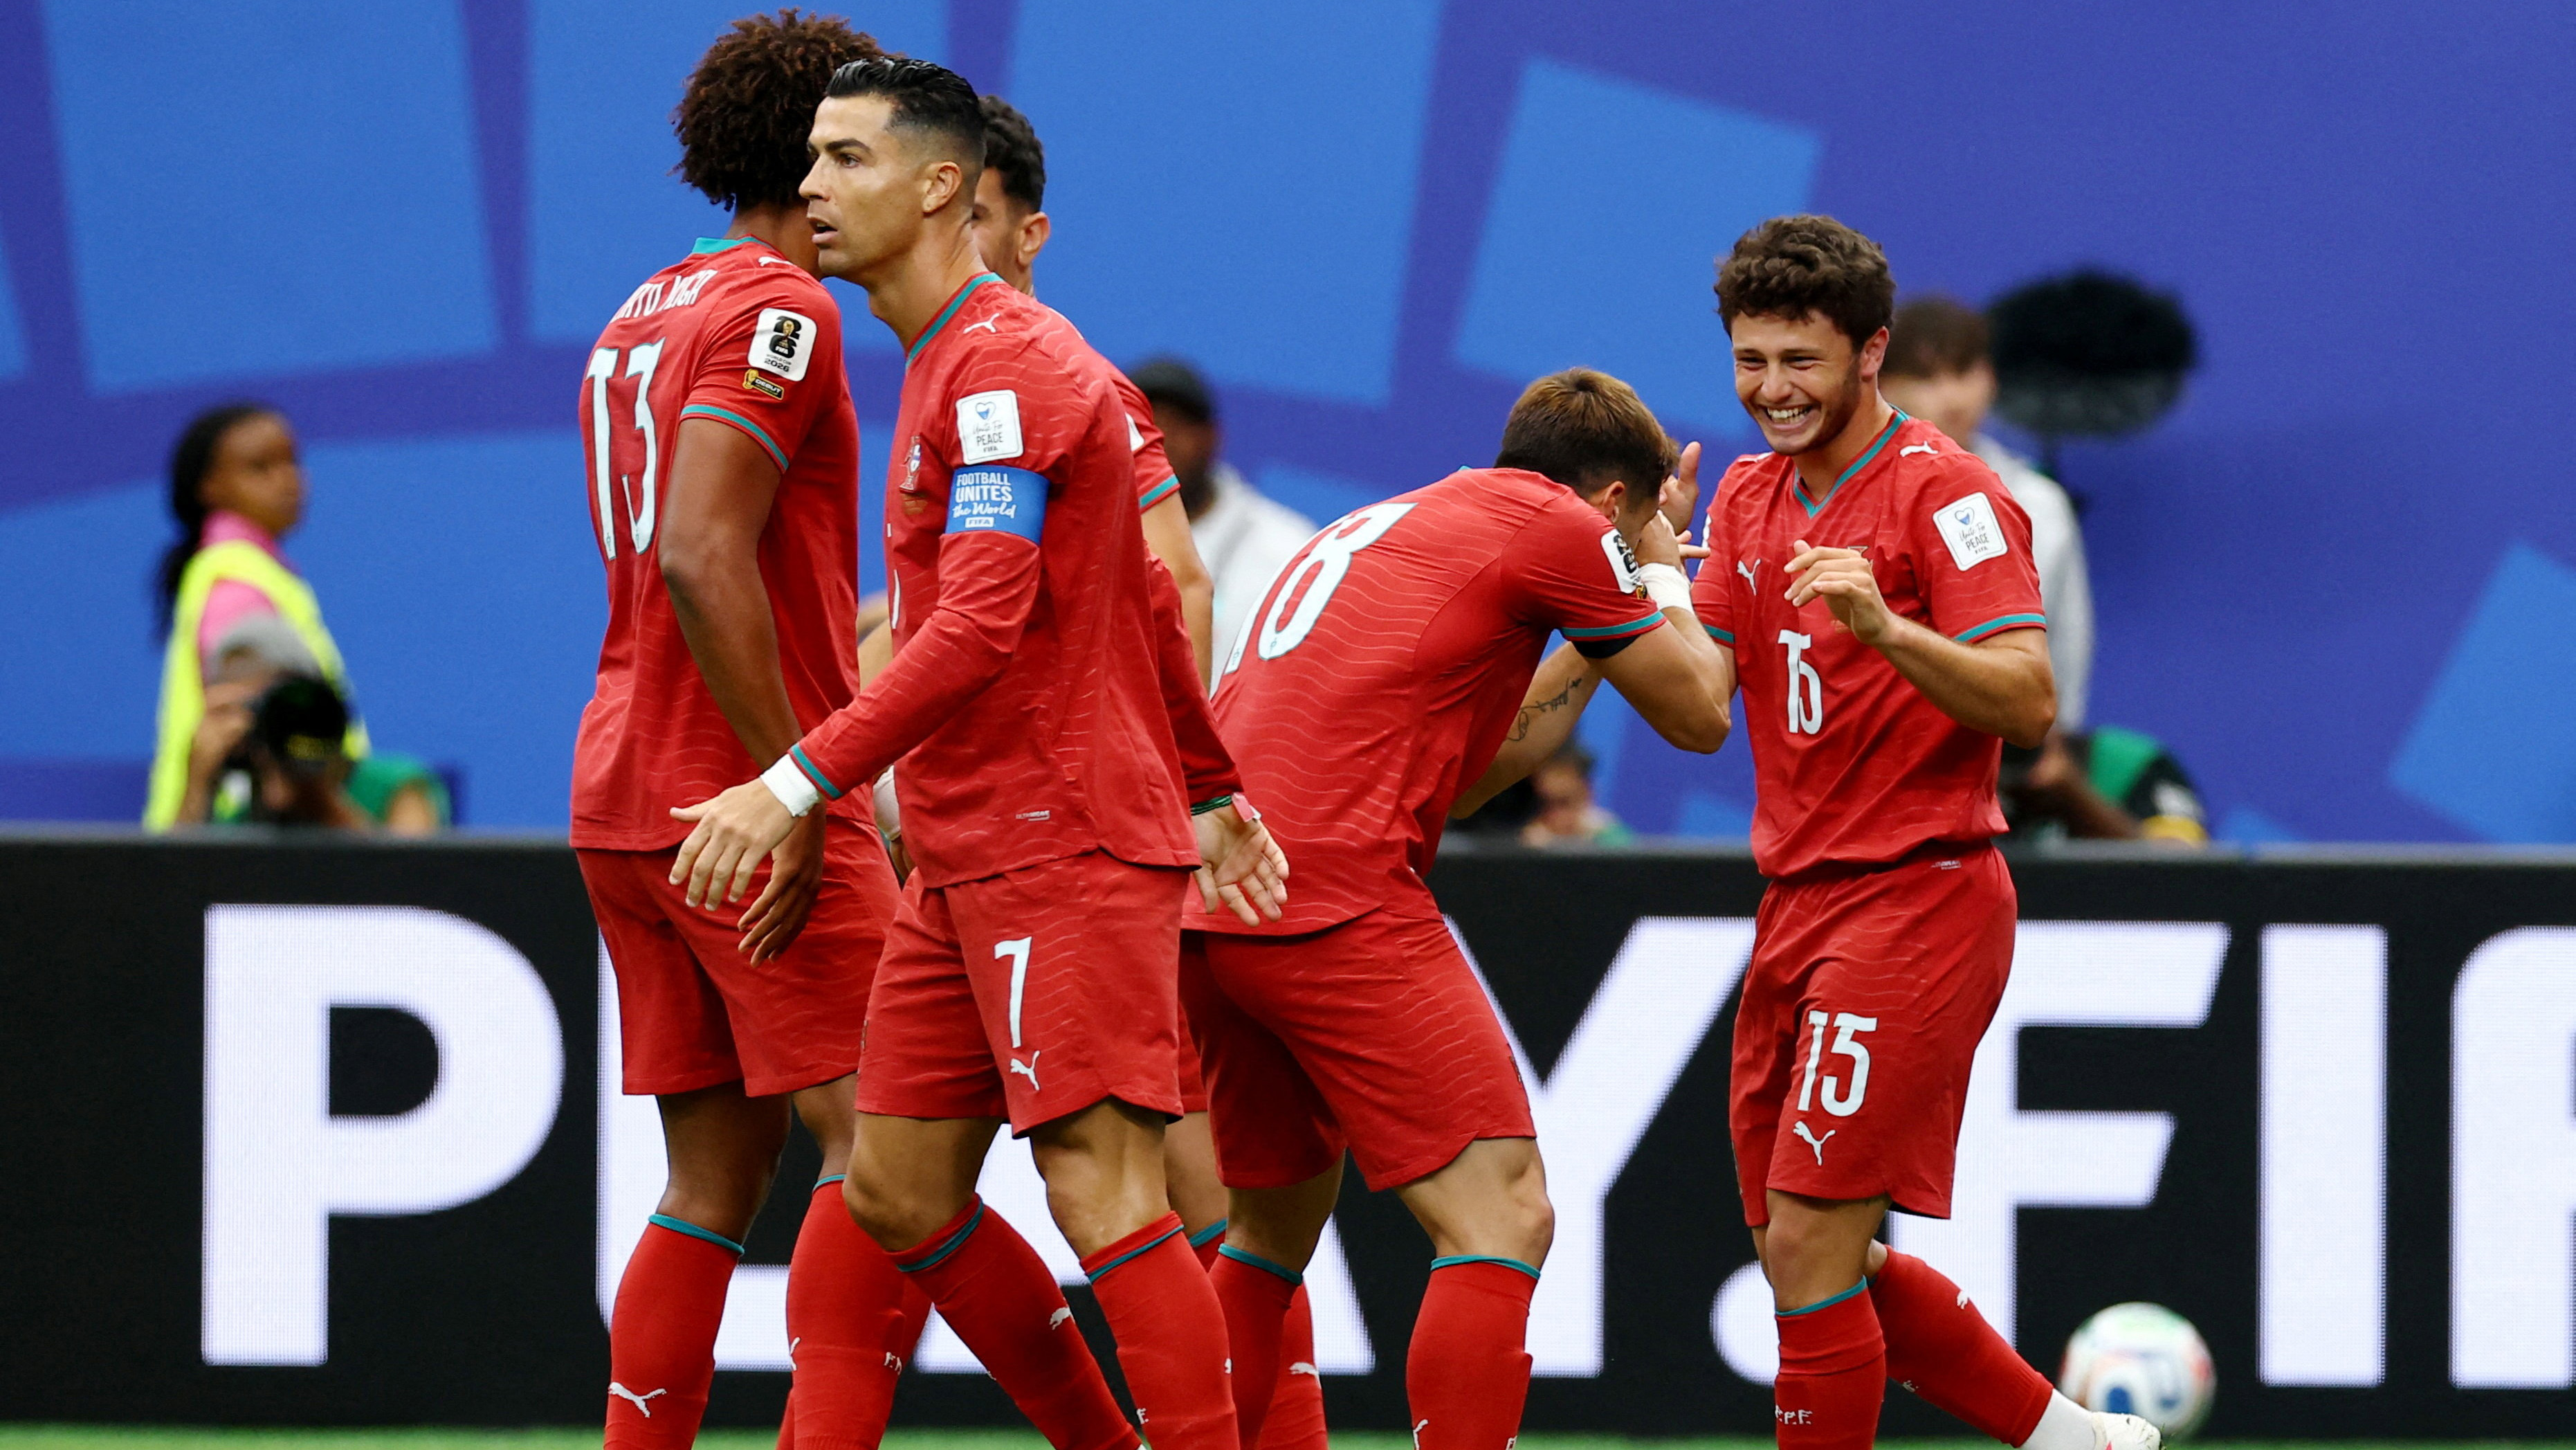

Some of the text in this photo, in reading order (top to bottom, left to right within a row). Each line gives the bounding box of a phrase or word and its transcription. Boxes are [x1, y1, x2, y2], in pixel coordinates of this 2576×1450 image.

[764, 358, 789, 372] 2026
[755, 379, 781, 393] DEBUT
[976, 432, 1003, 446] PEACE
[585, 337, 665, 560] 13
[956, 472, 1011, 487] FOOTBALL
[955, 485, 1013, 503] UNITES
[952, 502, 1016, 519] the World
[967, 518, 992, 526] FIFA
[1966, 533, 1989, 551] PEACE
[1778, 630, 1822, 735] 15
[994, 936, 1032, 1048] 7
[1798, 1011, 1876, 1117] 15
